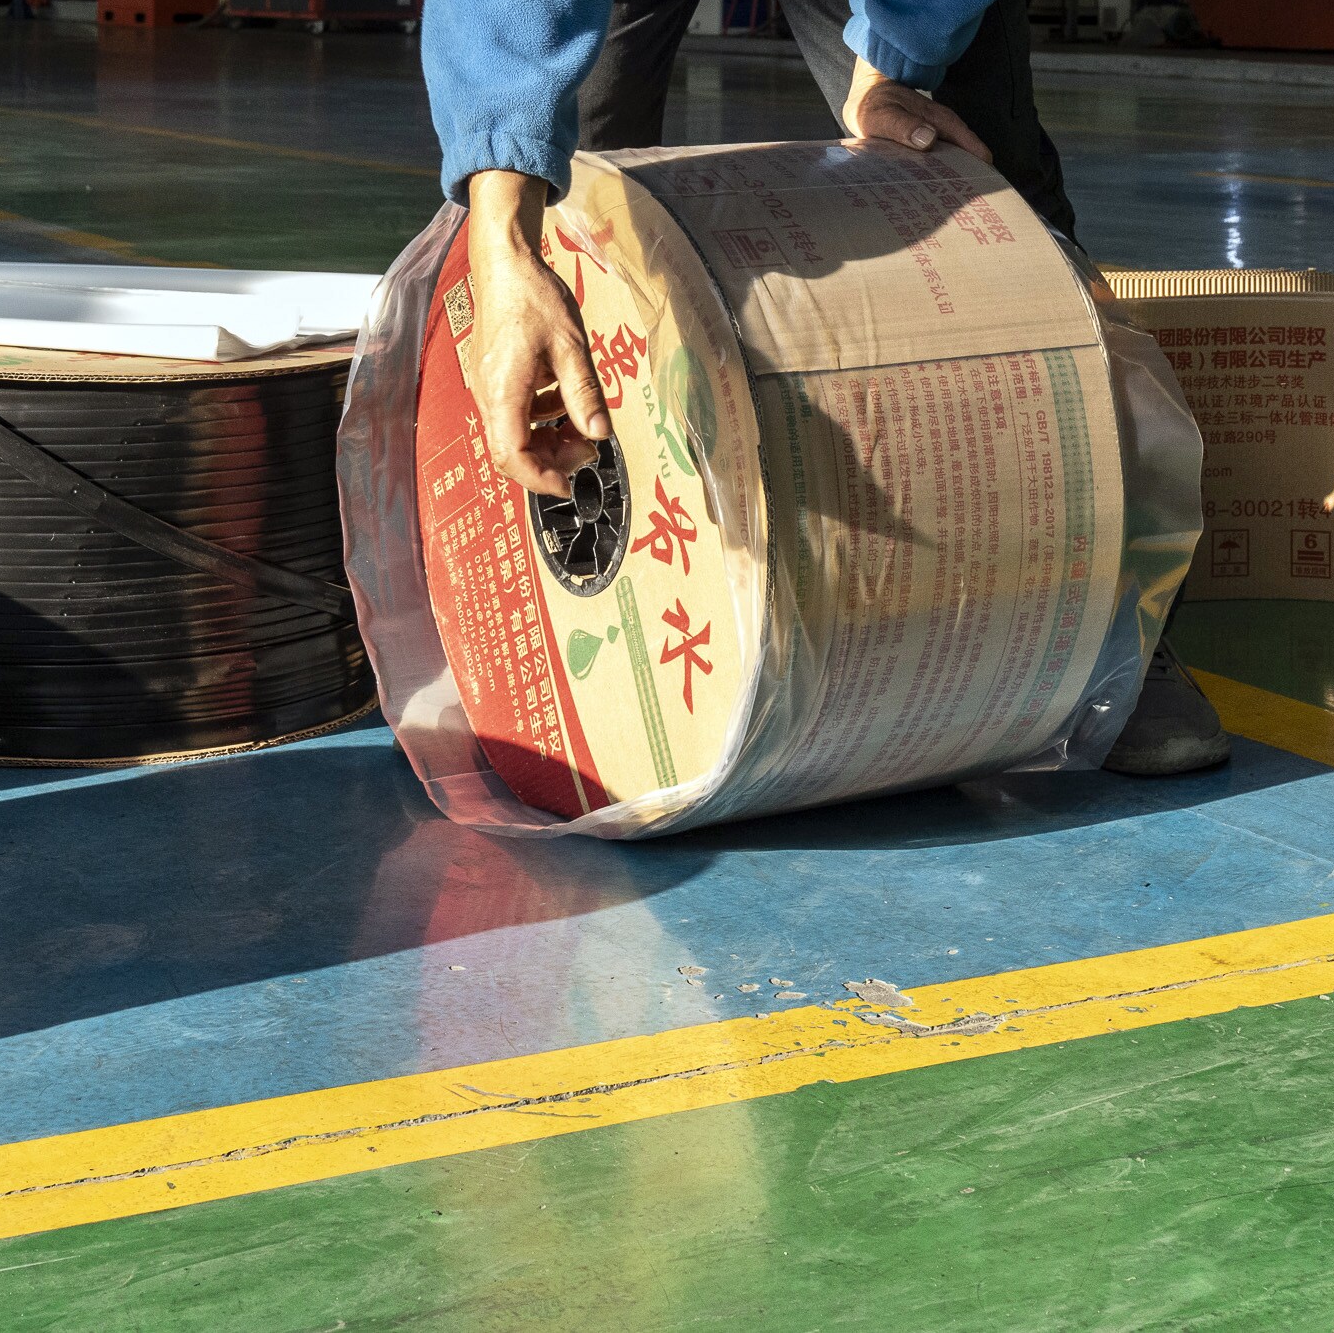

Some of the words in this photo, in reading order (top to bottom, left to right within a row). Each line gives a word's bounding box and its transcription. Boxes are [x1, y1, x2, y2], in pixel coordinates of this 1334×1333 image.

[430, 462, 466, 500] 合格证
[1304, 533, 1317, 549] 6
[481, 421, 566, 751] 水集团股份有限公司授权
